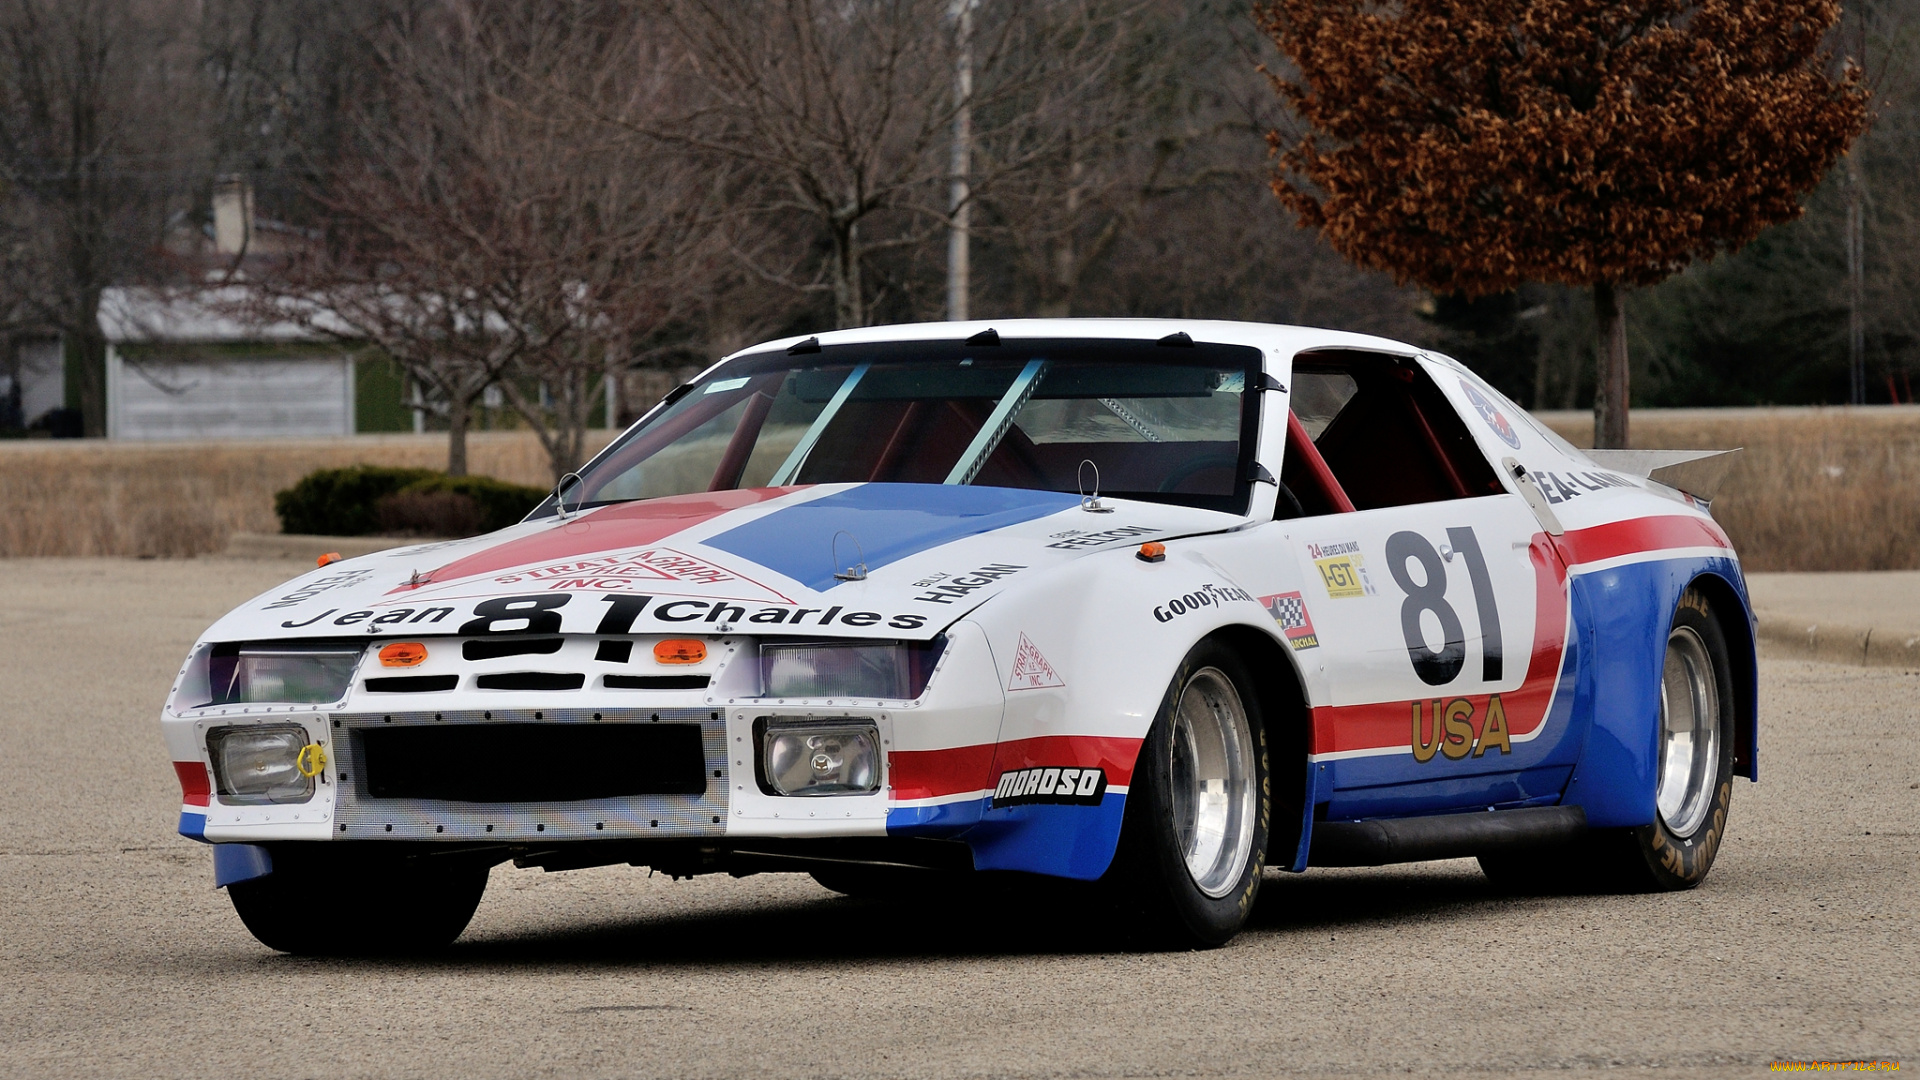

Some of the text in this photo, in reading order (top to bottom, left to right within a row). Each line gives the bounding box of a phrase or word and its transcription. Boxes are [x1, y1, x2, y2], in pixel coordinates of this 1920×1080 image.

[1045, 525, 1163, 550] FELTON
[1307, 543, 1323, 559] 24
[261, 568, 375, 610] FELTON
[549, 578, 632, 590] INC.
[912, 571, 951, 587] BILLY
[913, 563, 1029, 604] HAGAN
[1319, 563, 1355, 587] I-GT
[1153, 585, 1255, 623] GOODYEAR
[1385, 526, 1503, 686] 81
[281, 594, 927, 663] Jean 81 Charles
[1411, 693, 1511, 764] USA
[994, 768, 1101, 800] MOROSO
